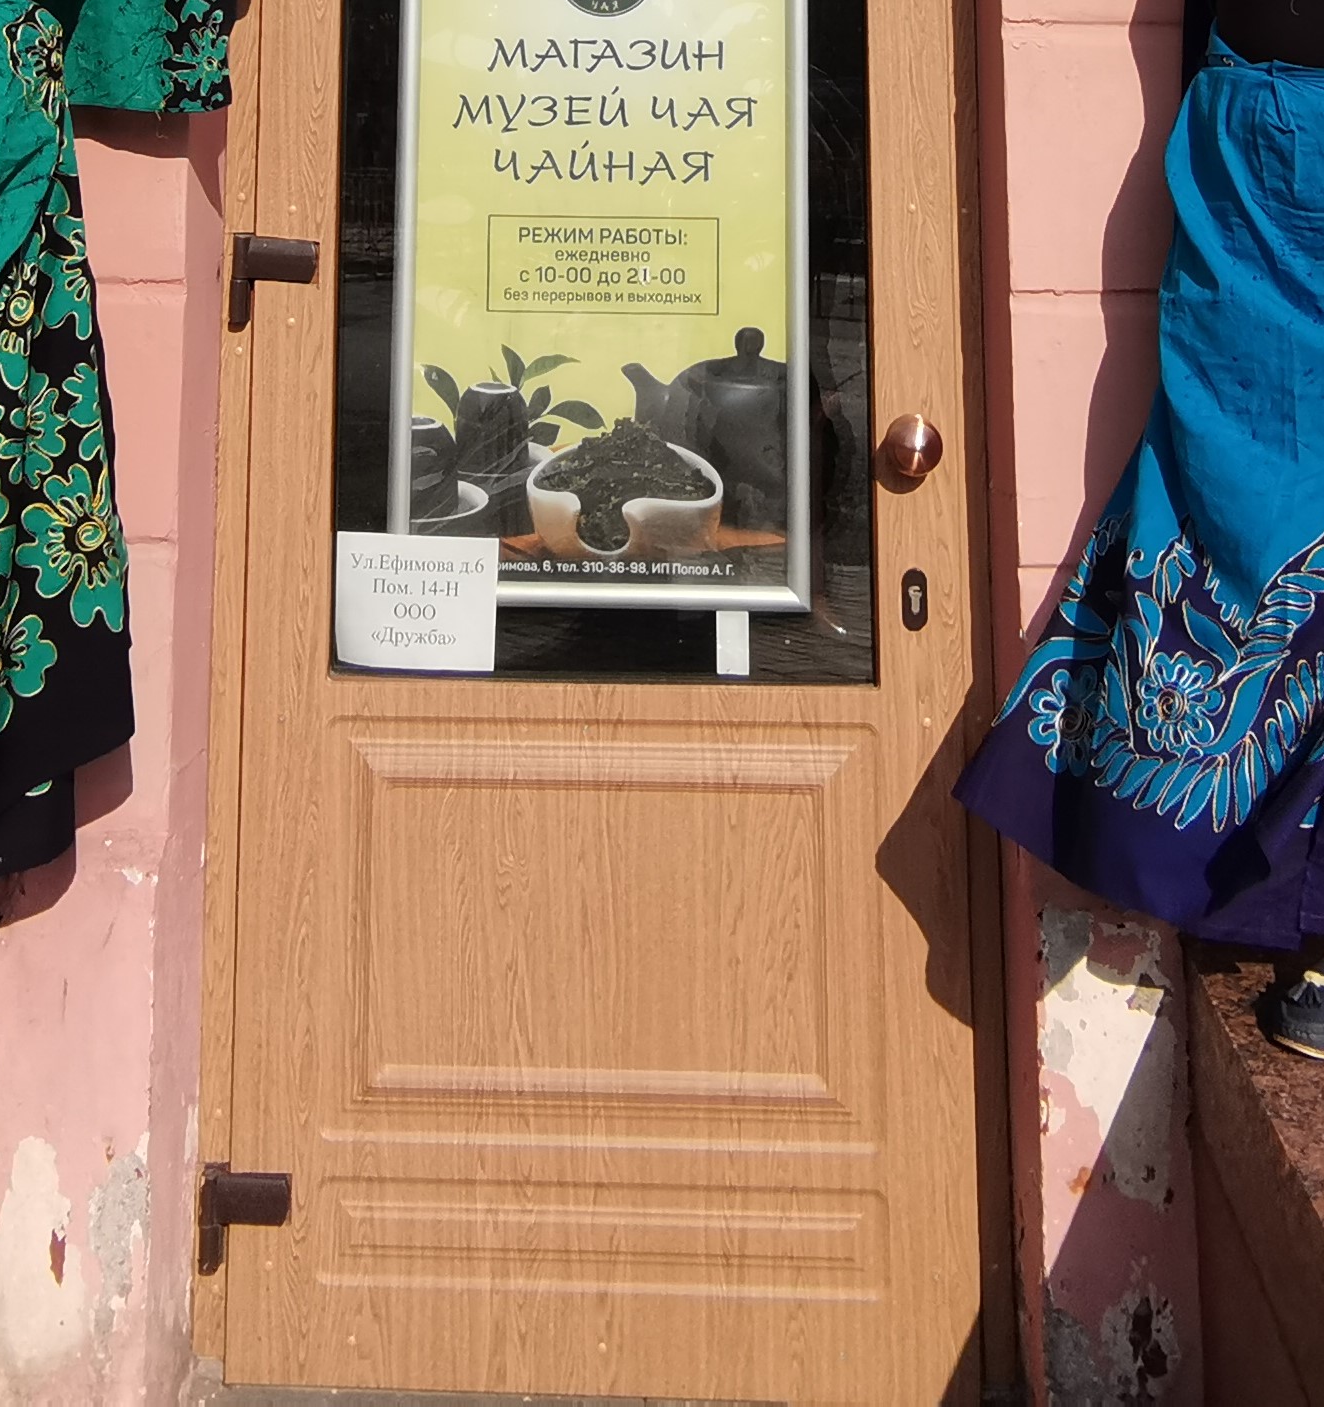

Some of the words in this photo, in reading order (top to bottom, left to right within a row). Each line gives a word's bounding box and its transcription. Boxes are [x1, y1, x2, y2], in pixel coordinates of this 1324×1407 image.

[591, 0, 619, 11] ЧАЯ
[487, 38, 724, 72] МАГАЗИН
[452, 86, 629, 133] МУЗЕЙ
[651, 96, 758, 131] ЧАЯ
[494, 140, 715, 185] ЧАЙНАЯ
[518, 227, 594, 244] РЕЖИМ
[599, 228, 688, 245] РАБОТЫ:
[555, 250, 651, 264] ежедневно
[519, 270, 530, 283] с
[535, 266, 592, 283] 10-00
[597, 270, 621, 286] до
[626, 268, 686, 286] 21-00
[503, 288, 529, 302] без
[533, 291, 612, 305] перерывов
[615, 293, 624, 302] и
[628, 292, 702, 305] выходных
[459, 558, 485, 574] д.6
[557, 562, 579, 573] тел.
[582, 560, 649, 574] 310-36-98,
[652, 563, 669, 574] ИП
[672, 563, 709, 576] Попов
[373, 578, 413, 595] Пом.
[420, 580, 459, 597] 14-Н
[394, 602, 436, 621] ООО
[371, 627, 457, 647] «Дружба»
